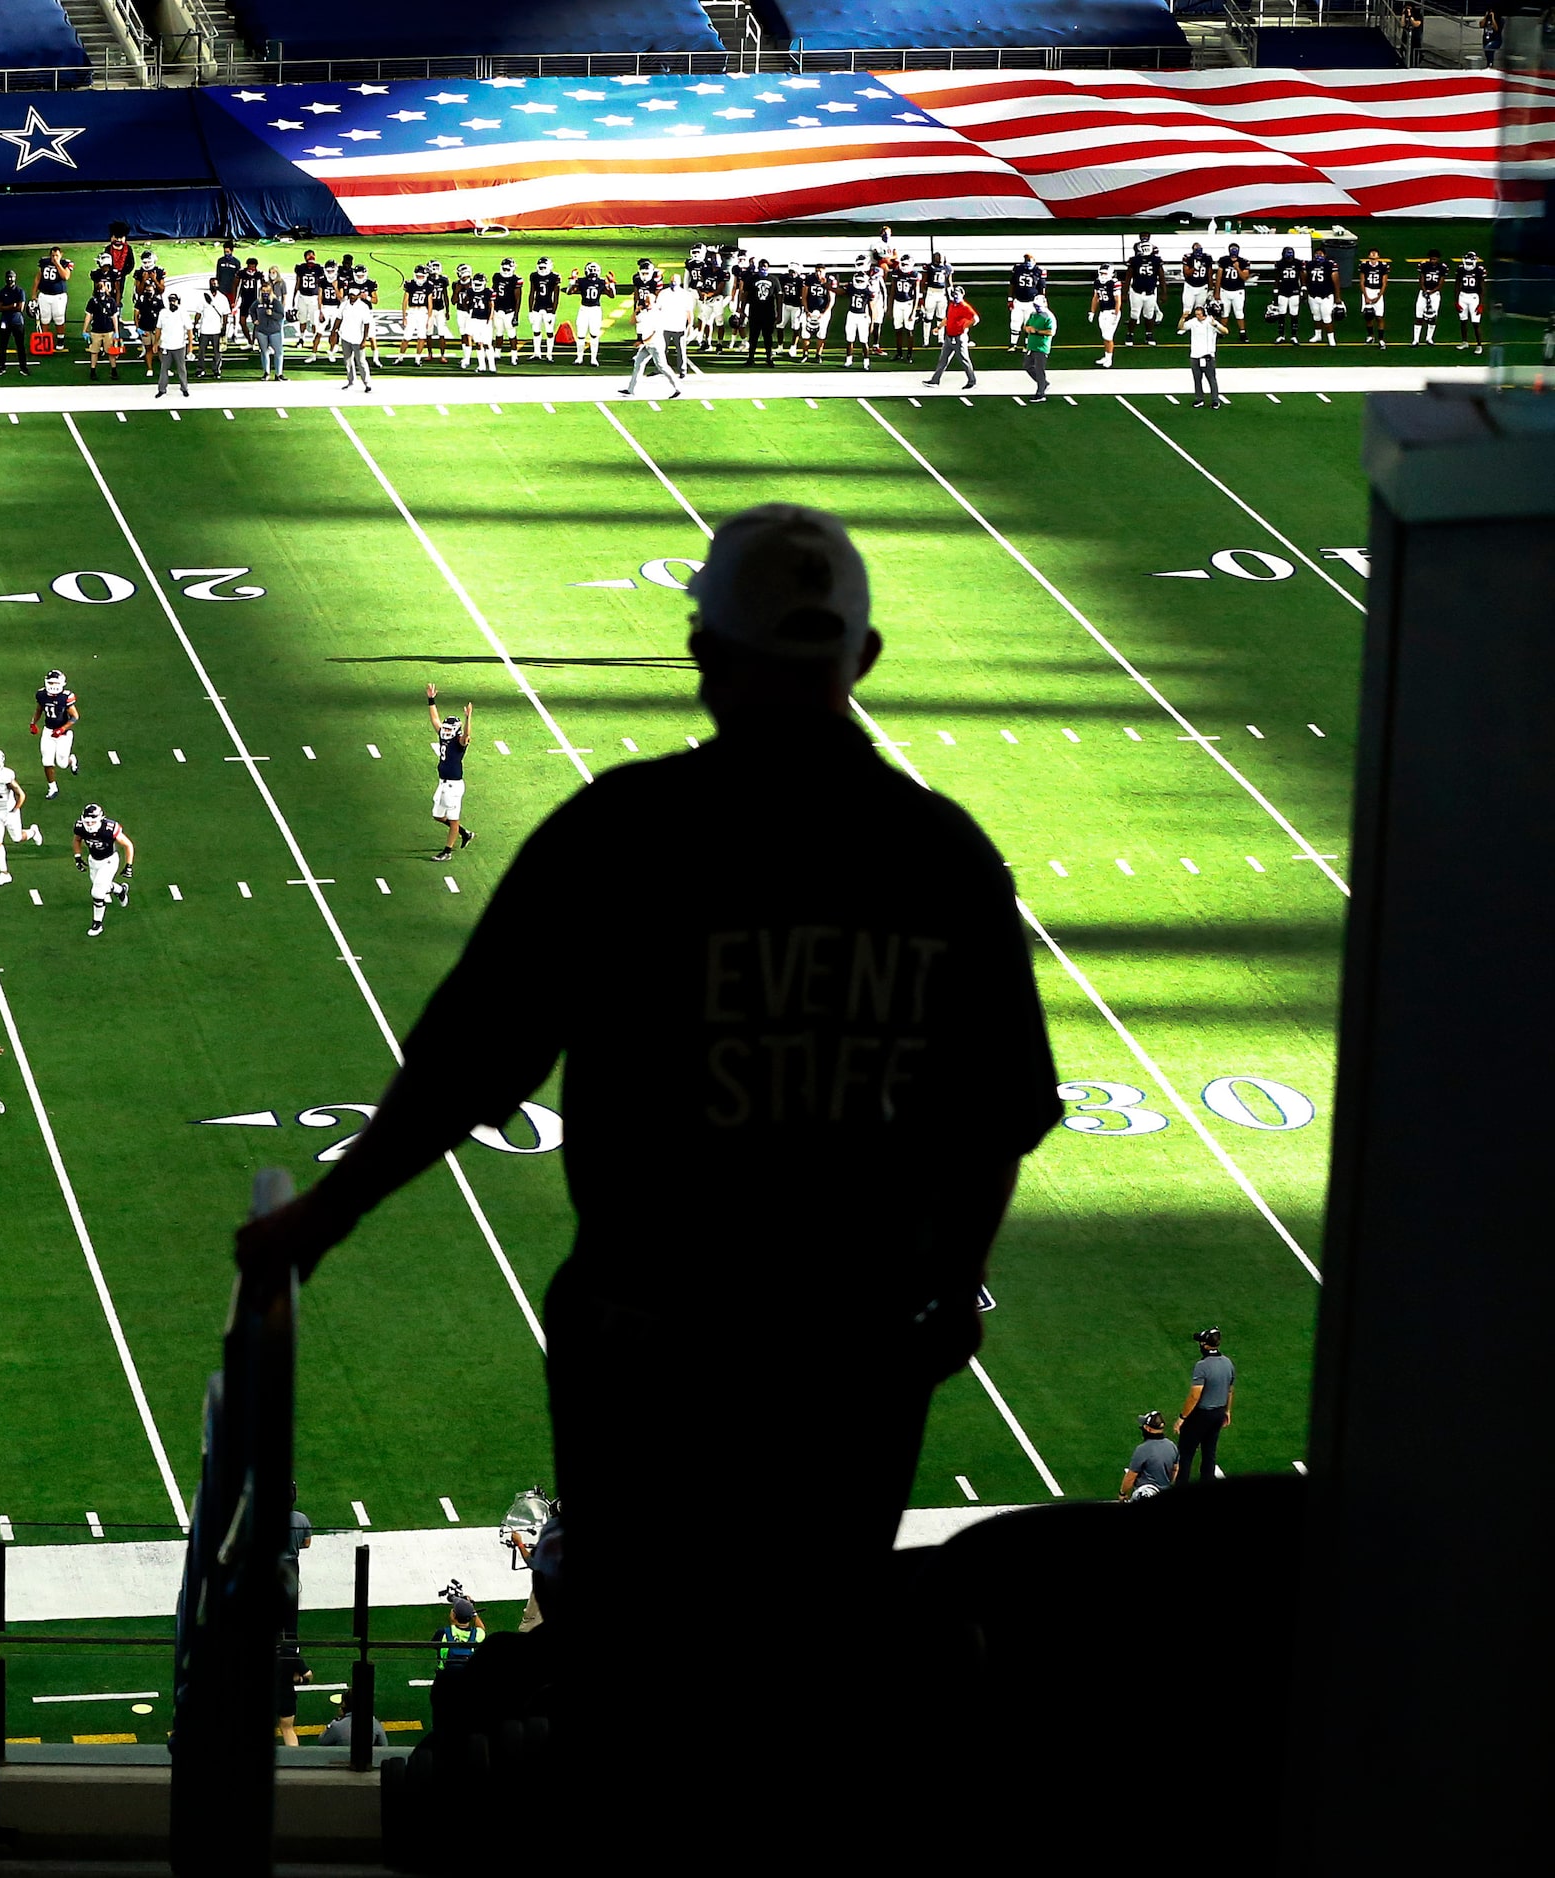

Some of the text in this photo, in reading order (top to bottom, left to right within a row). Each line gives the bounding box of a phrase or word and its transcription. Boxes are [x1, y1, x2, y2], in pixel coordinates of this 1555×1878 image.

[43, 268, 57, 280] 66
[1224, 268, 1238, 280] 70
[1310, 270, 1324, 282] 75
[1366, 273, 1380, 285] 42
[302, 276, 316, 289] 62
[1018, 275, 1033, 288] 53
[498, 284, 505, 297] 5
[539, 283, 547, 296] 3
[585, 287, 598, 299] 10
[810, 286, 824, 297] 52
[411, 293, 426, 304] 20
[851, 296, 863, 308] 16
[34, 335, 51, 351] 20
[44, 705, 57, 719] 11
[705, 925, 948, 1023] EVENT
[1056, 1075, 1315, 1136] 30
